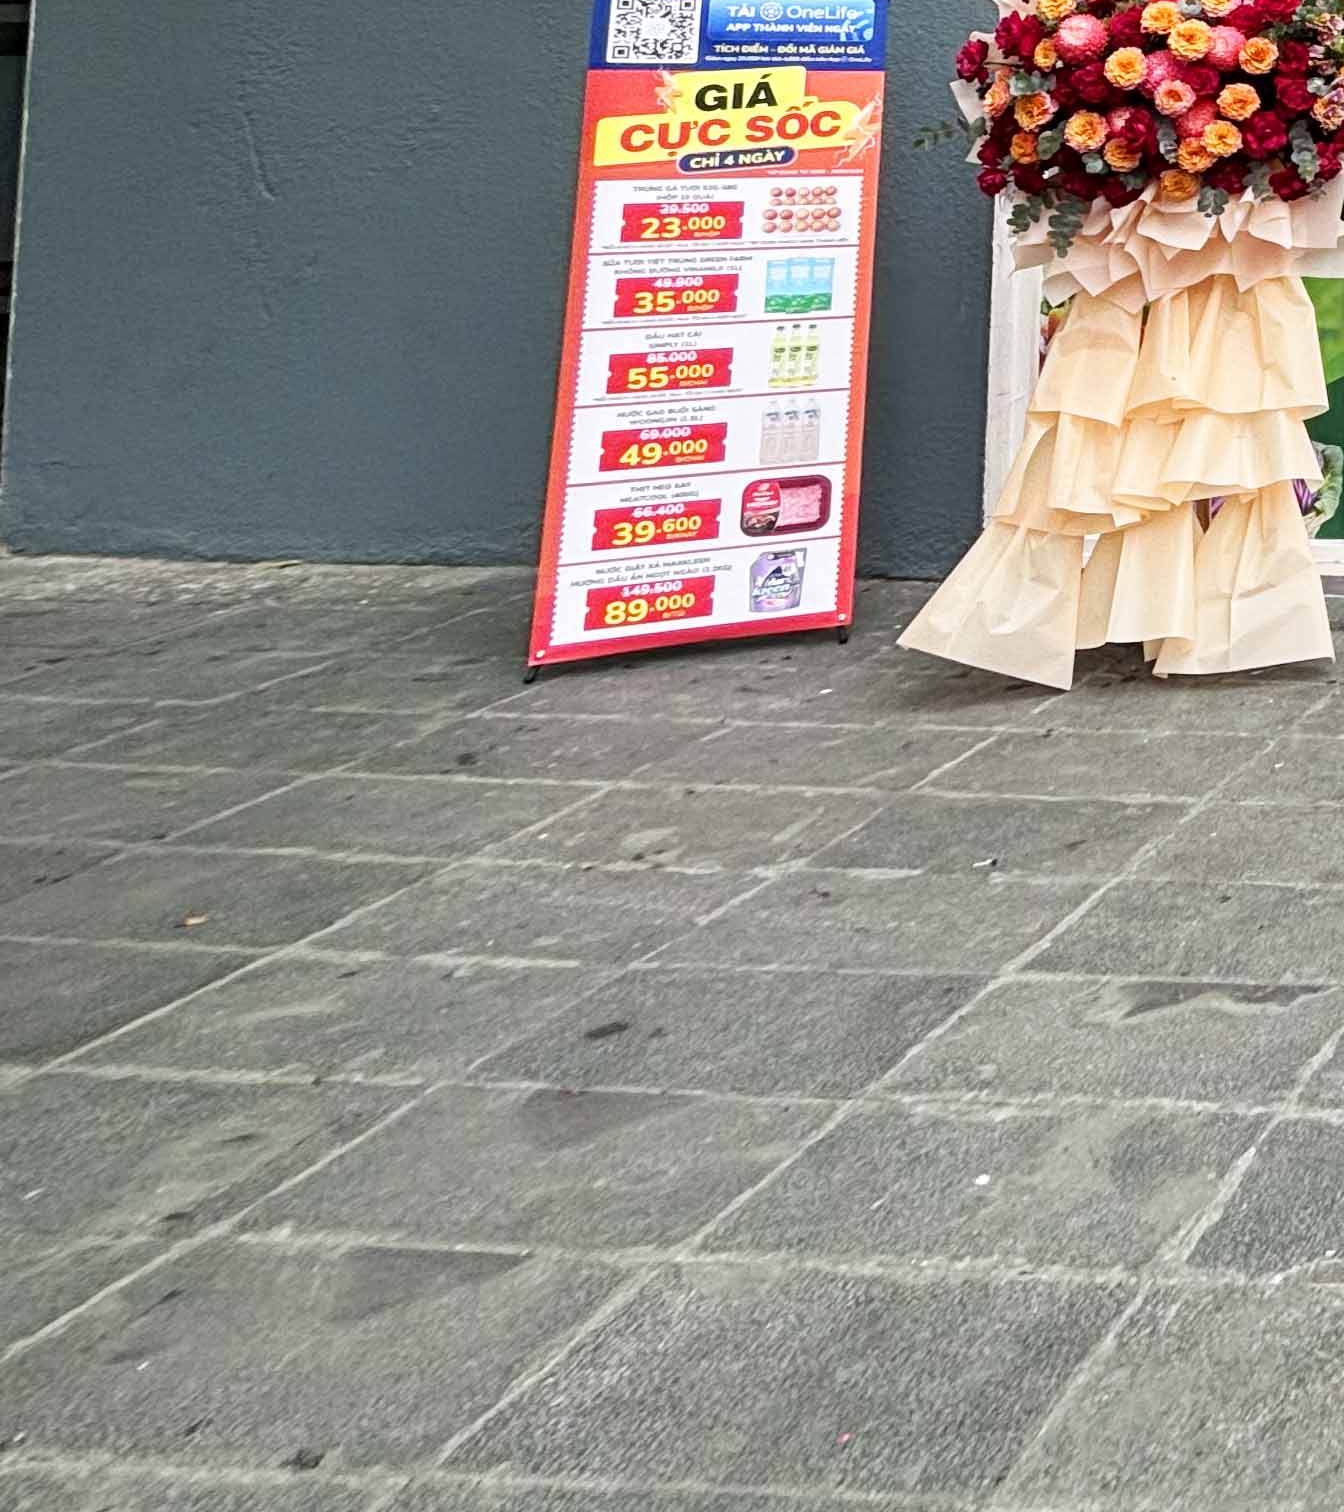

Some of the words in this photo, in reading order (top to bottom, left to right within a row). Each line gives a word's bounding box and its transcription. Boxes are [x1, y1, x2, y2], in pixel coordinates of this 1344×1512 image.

[727, 1, 756, 19] TẢI
[786, 2, 859, 21] OneLife
[693, 74, 779, 113] GIÁ
[619, 116, 732, 158] CỰC
[744, 100, 844, 144] SỐC
[688, 152, 721, 170] CHỈ
[722, 153, 737, 167] 4
[737, 148, 786, 166] NGÀY
[640, 215, 727, 240] 23.000
[633, 289, 721, 314] 35.000
[626, 363, 715, 390] 55.000
[618, 438, 709, 466] 49.000
[611, 515, 703, 546] 39.600
[603, 592, 696, 626] 89.000
